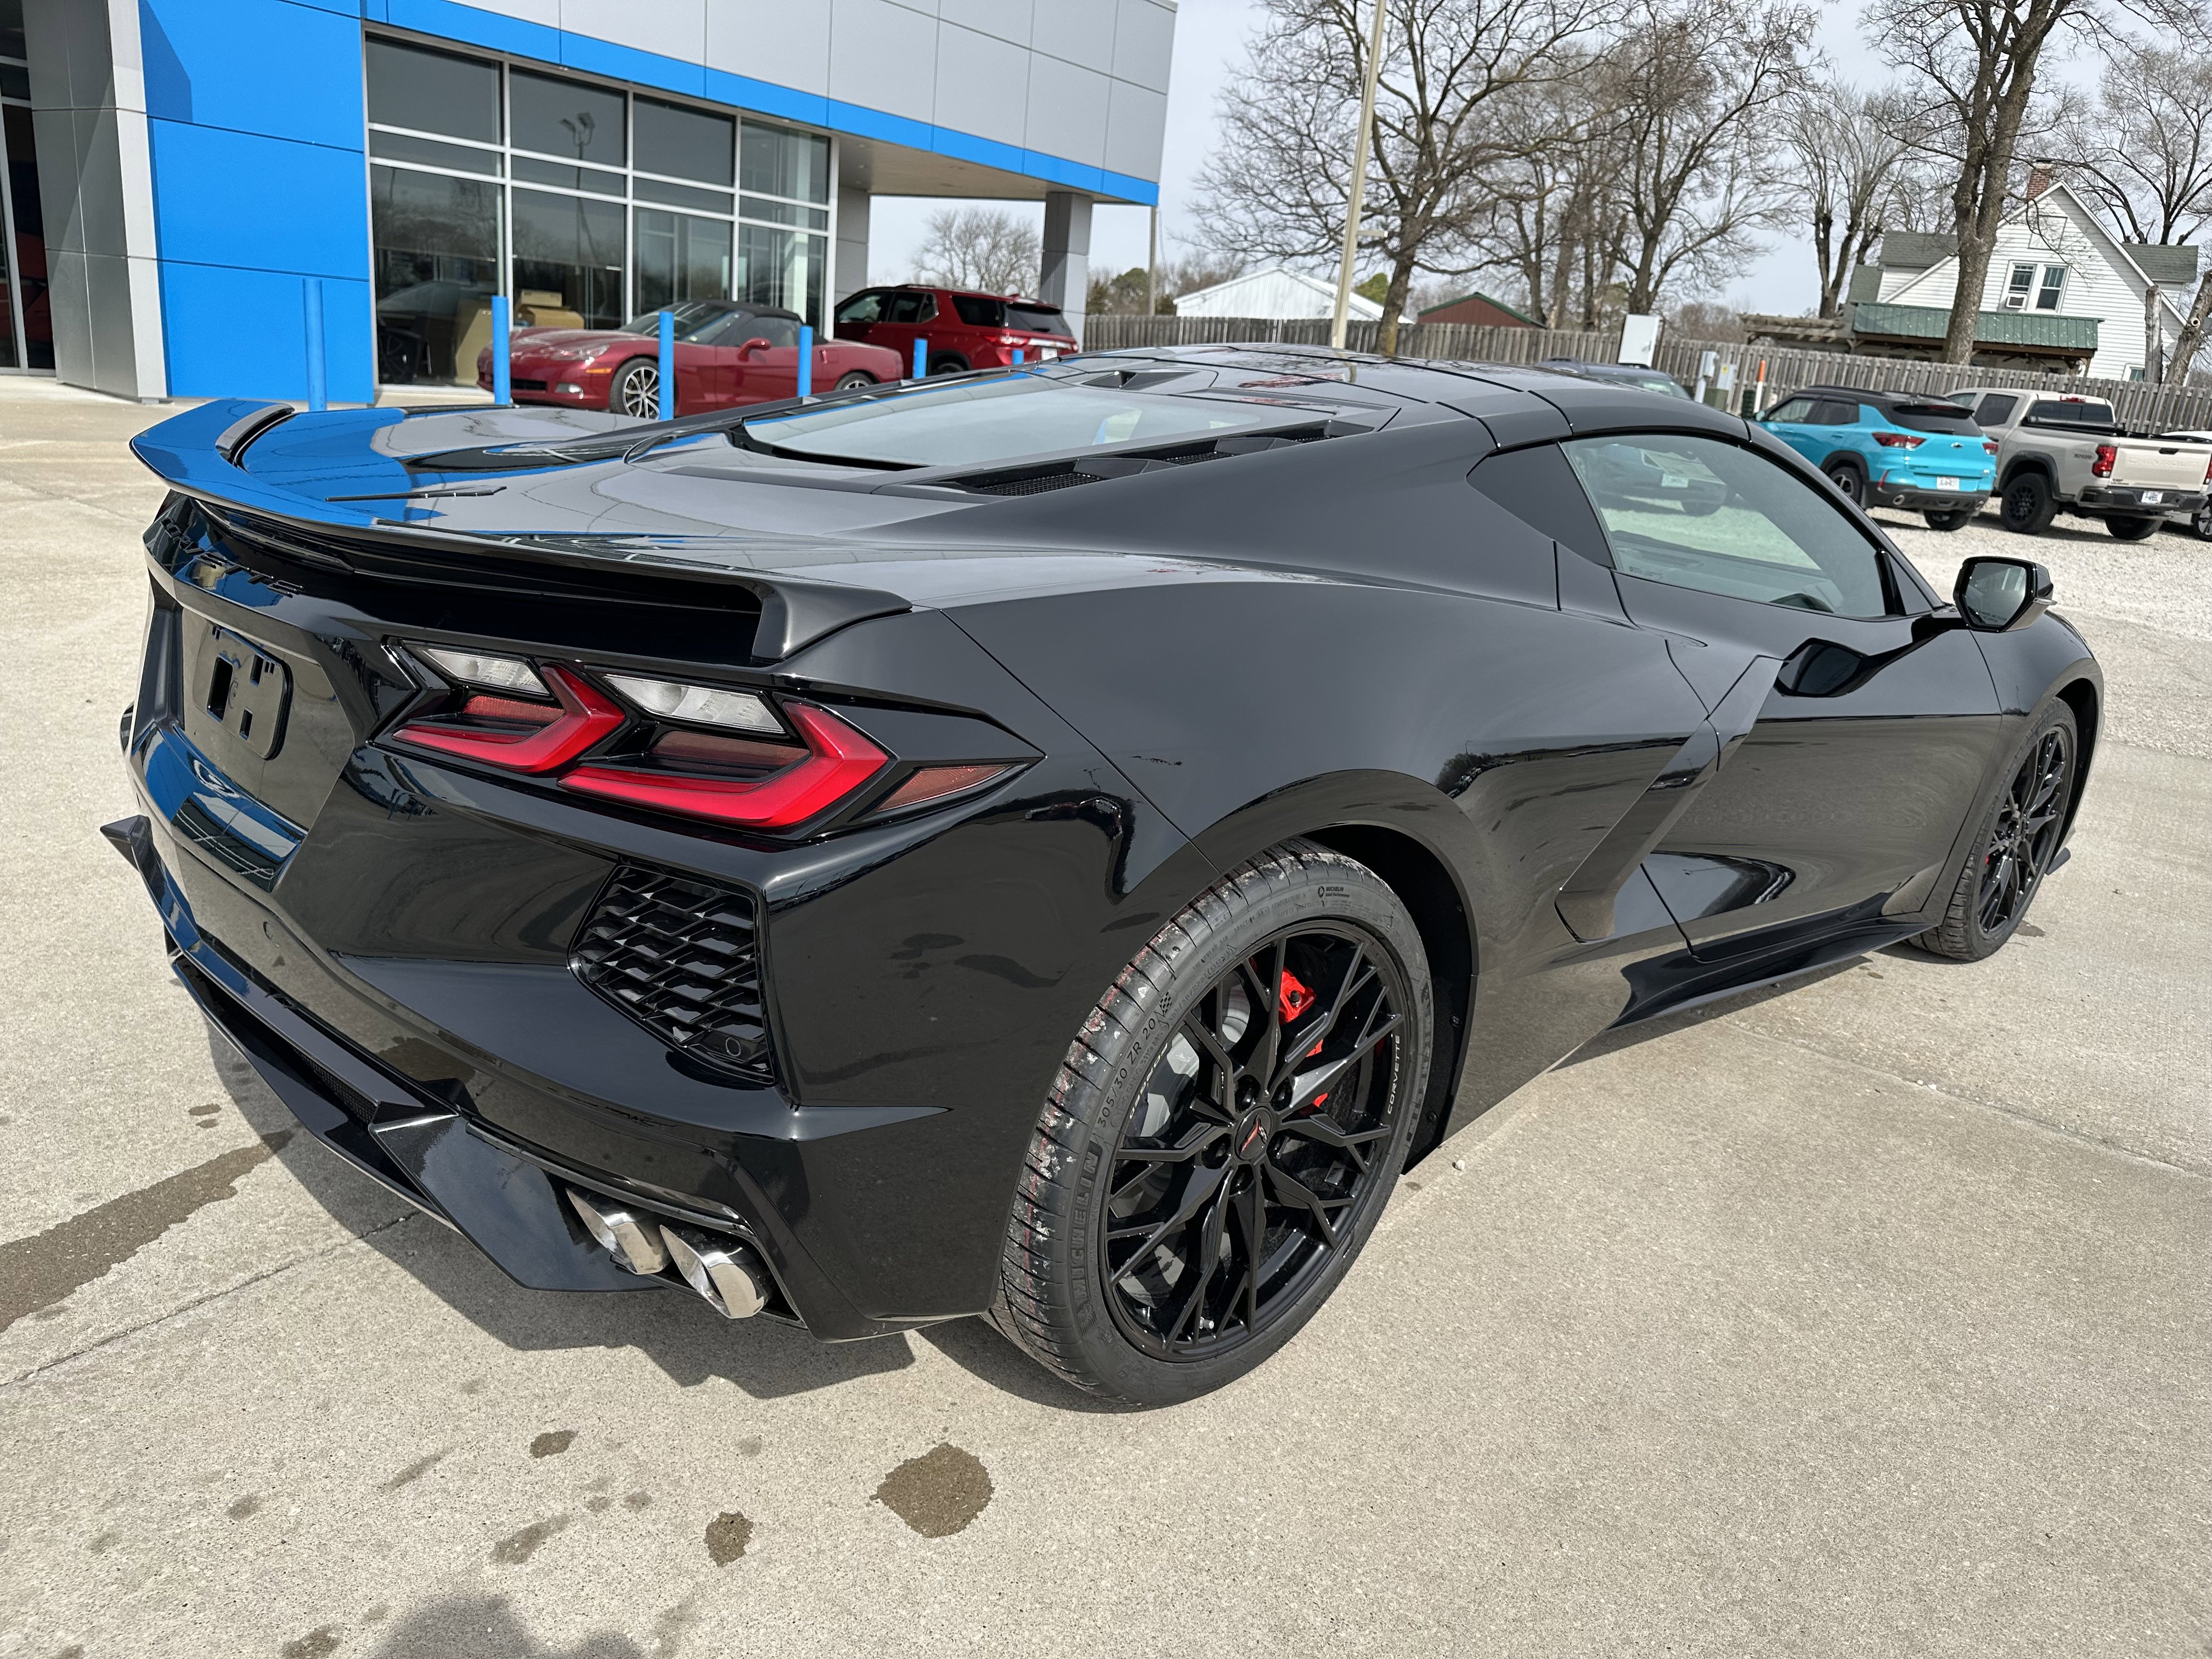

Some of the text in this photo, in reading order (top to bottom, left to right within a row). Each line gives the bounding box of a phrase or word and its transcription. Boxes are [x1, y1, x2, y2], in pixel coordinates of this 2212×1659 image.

[1098, 1018, 1155, 1127] 305/30 ZR 20
[1387, 1035, 1400, 1115] CORVETTE
[1071, 1151, 1098, 1300] MICHELIN
